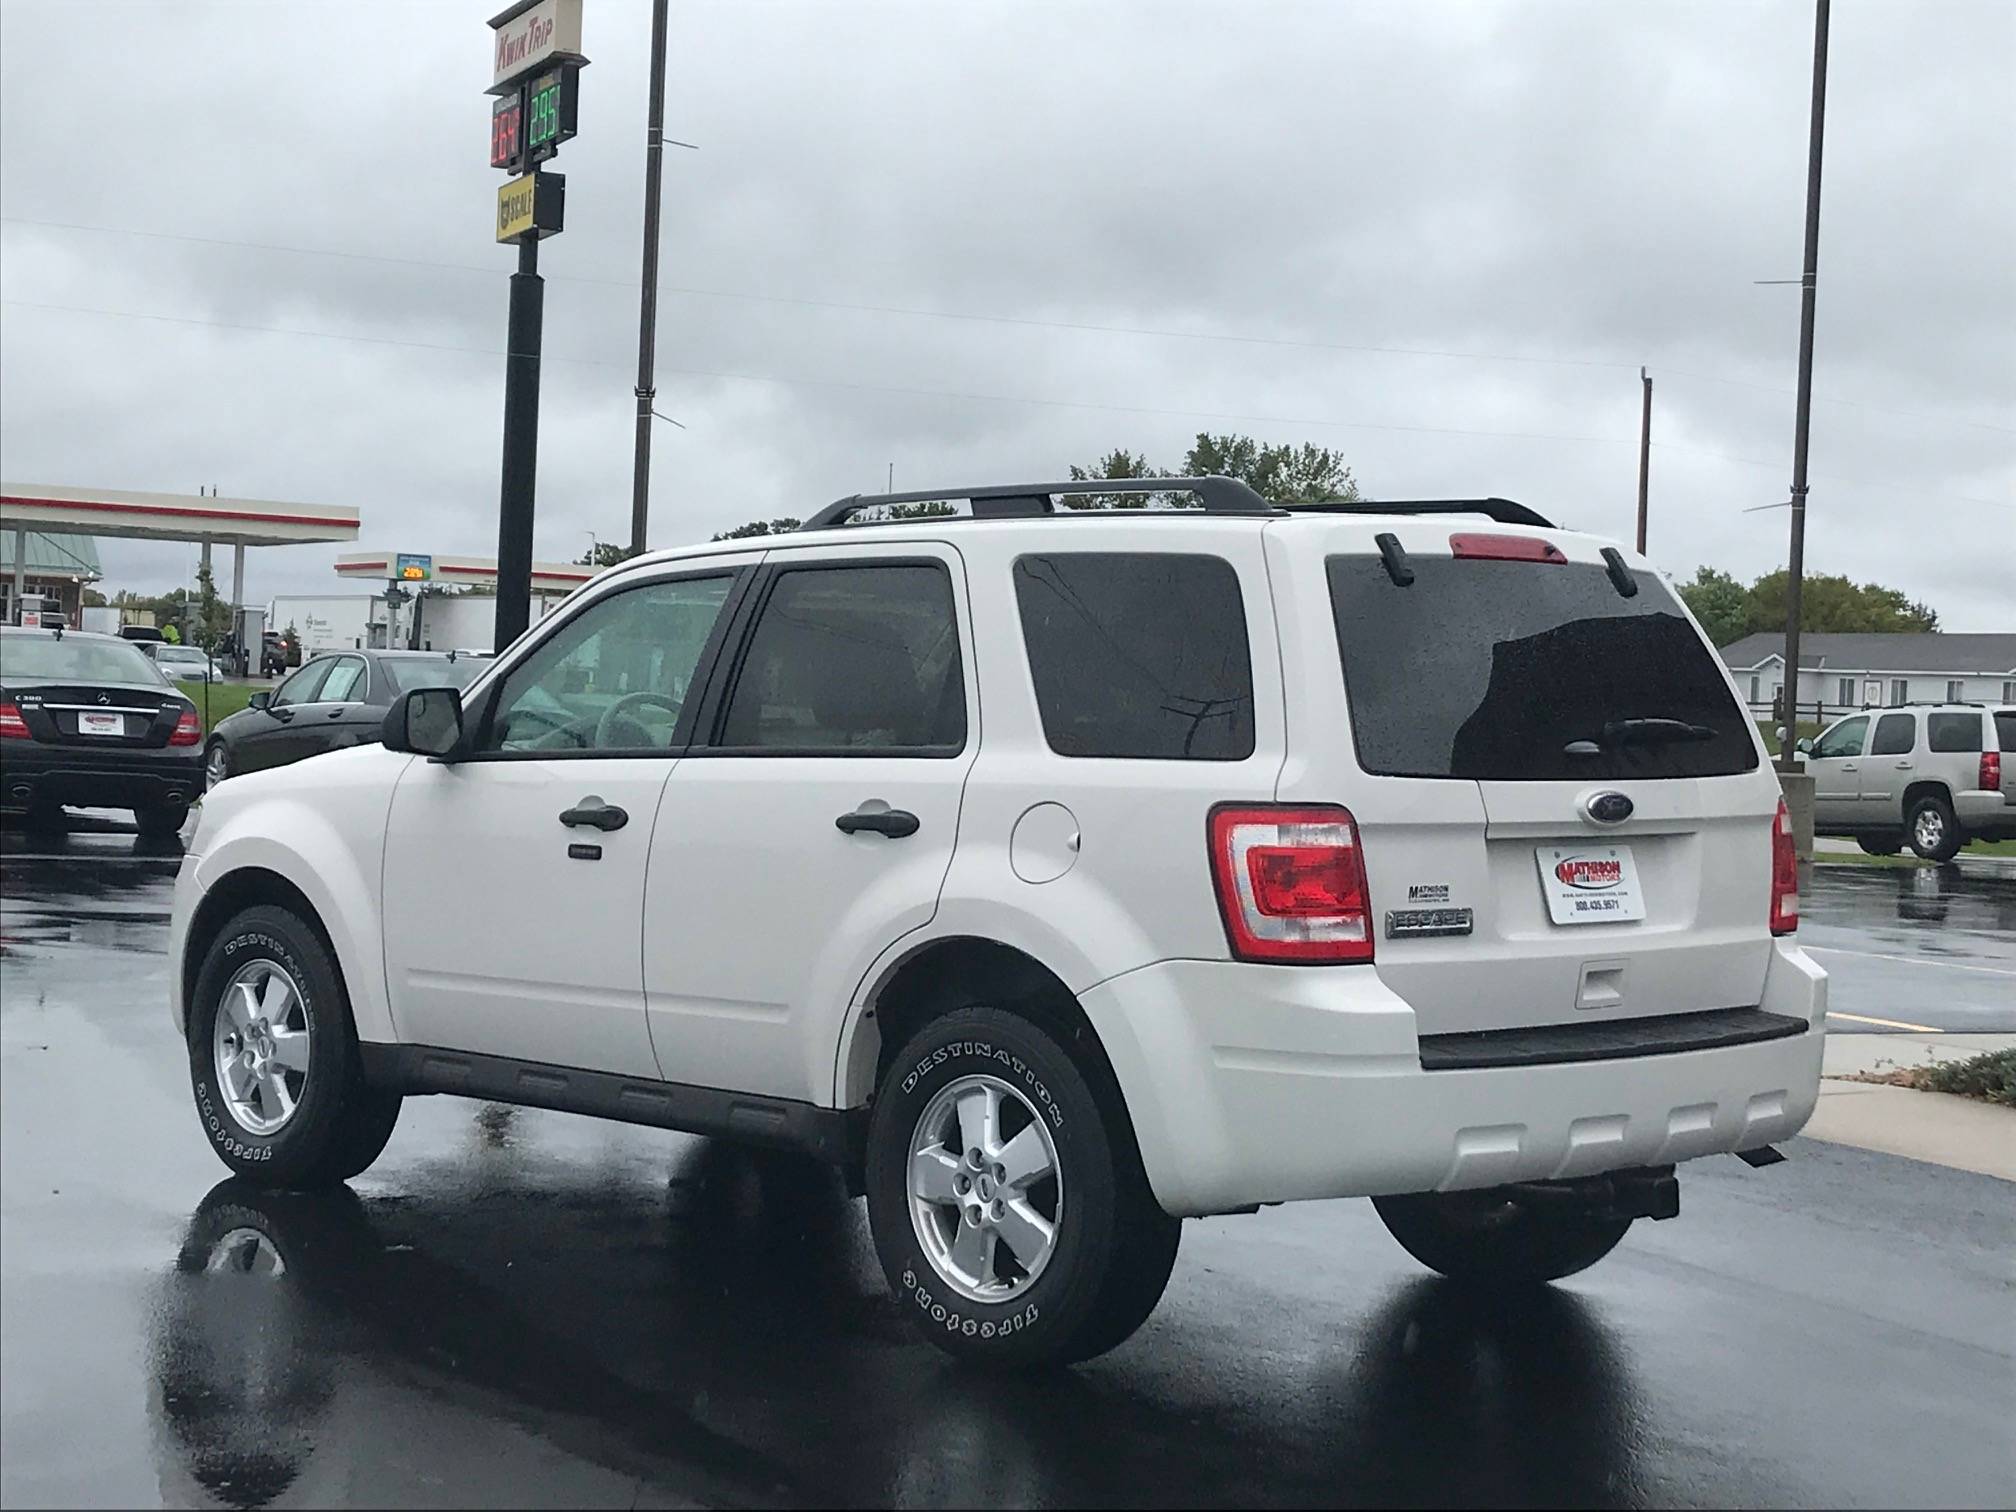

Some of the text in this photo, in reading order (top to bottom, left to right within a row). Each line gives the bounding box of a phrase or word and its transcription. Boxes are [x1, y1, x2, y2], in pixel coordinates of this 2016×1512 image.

[1559, 861, 1622, 884] MATHISON
[1409, 885, 1449, 899] MATHISON
[1396, 910, 1467, 928] ESCAPE
[901, 1041, 1063, 1129] DESTINATION
